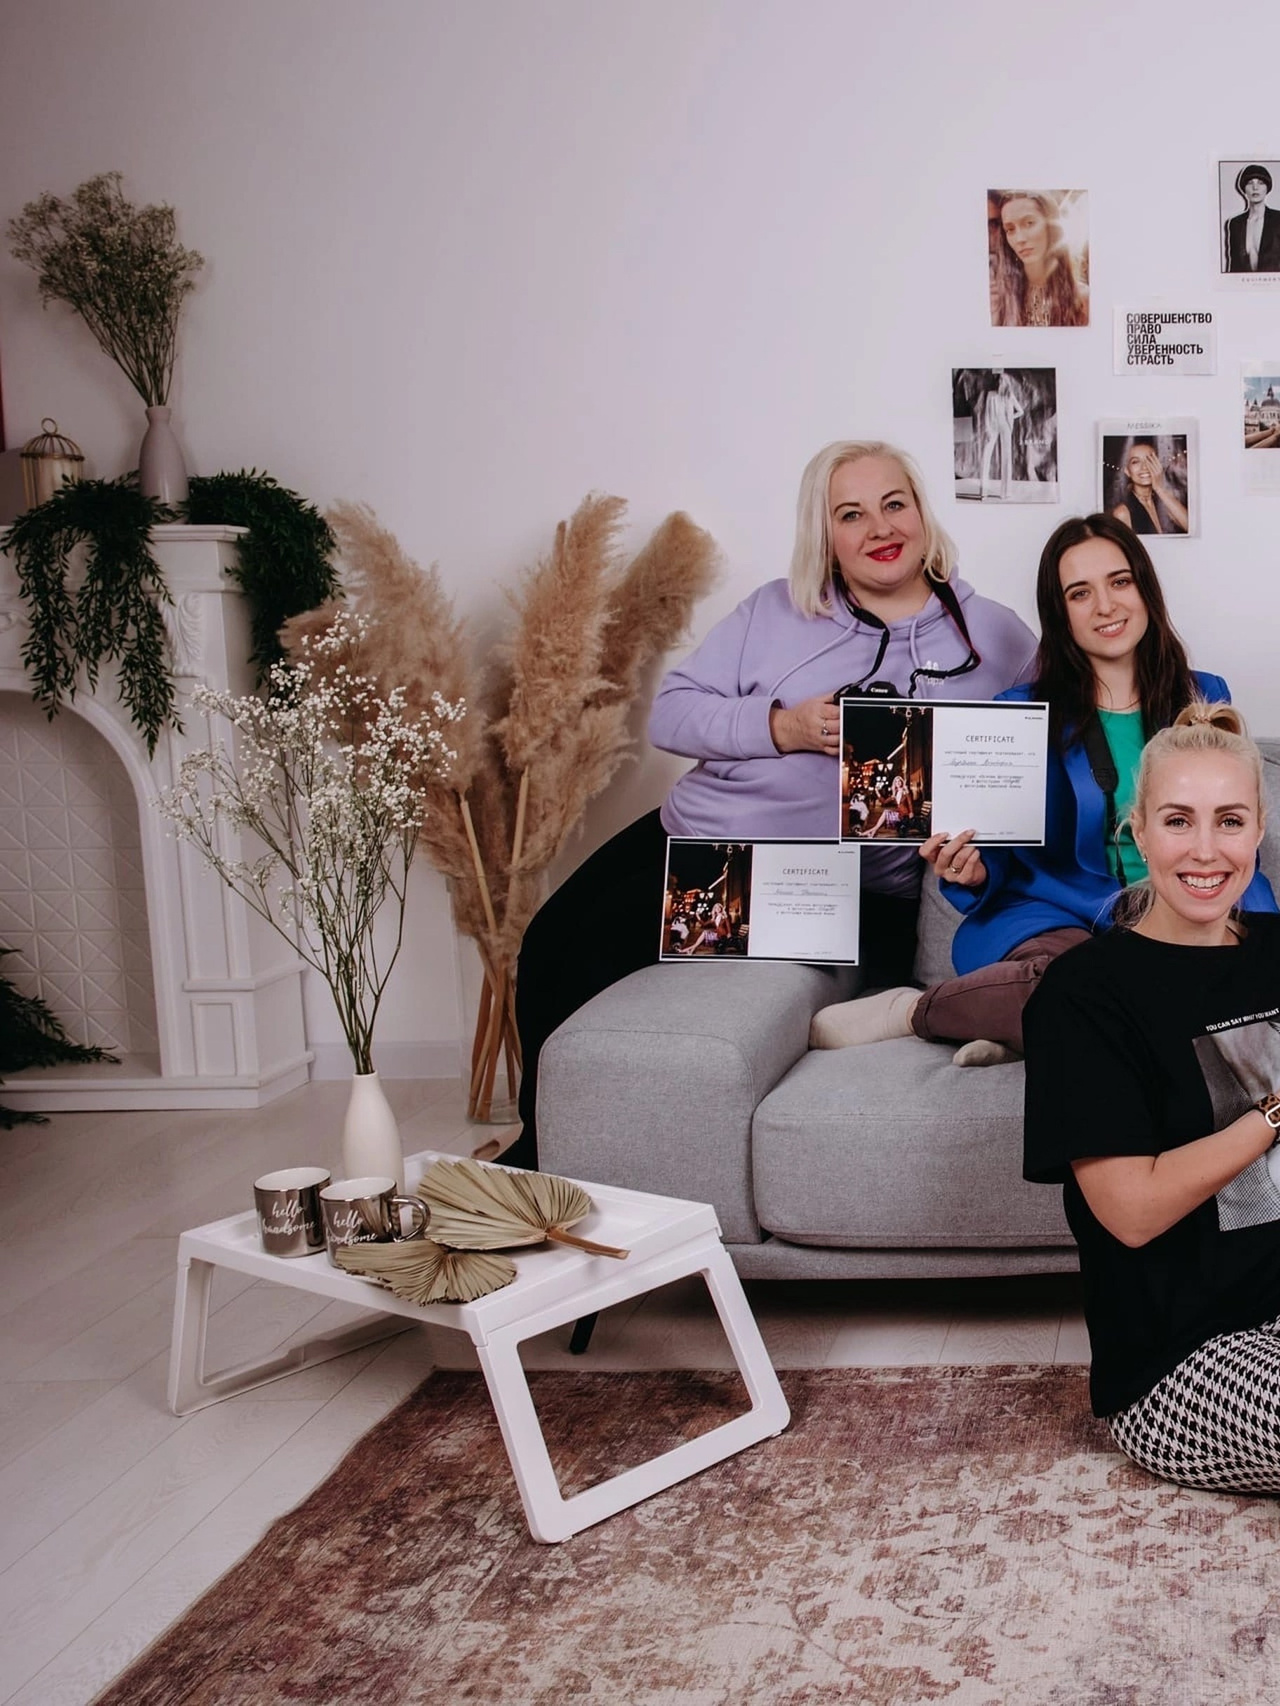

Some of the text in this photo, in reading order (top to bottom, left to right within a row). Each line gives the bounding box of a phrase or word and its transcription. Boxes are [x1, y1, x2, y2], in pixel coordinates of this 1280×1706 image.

[1126, 313, 1213, 324] СОВЕРШЕНСТВО
[1126, 323, 1162, 334] ПРАВО
[1126, 334, 1157, 344] СИЛА
[1127, 344, 1204, 355] УВЕРЕННОСТЬ
[1127, 354, 1175, 365] СТРАСТЬ
[965, 735, 1015, 743] CERTIFICATE
[782, 868, 829, 876] CERTIFICATE
[1206, 1024, 1217, 1032] YOU
[1217, 1021, 1231, 1029] CAN
[1230, 1017, 1243, 1026] SAY
[1255, 1012, 1265, 1020] YOU
[271, 1200, 305, 1218] hello
[333, 1208, 364, 1228] hello
[261, 1217, 316, 1236] handsome
